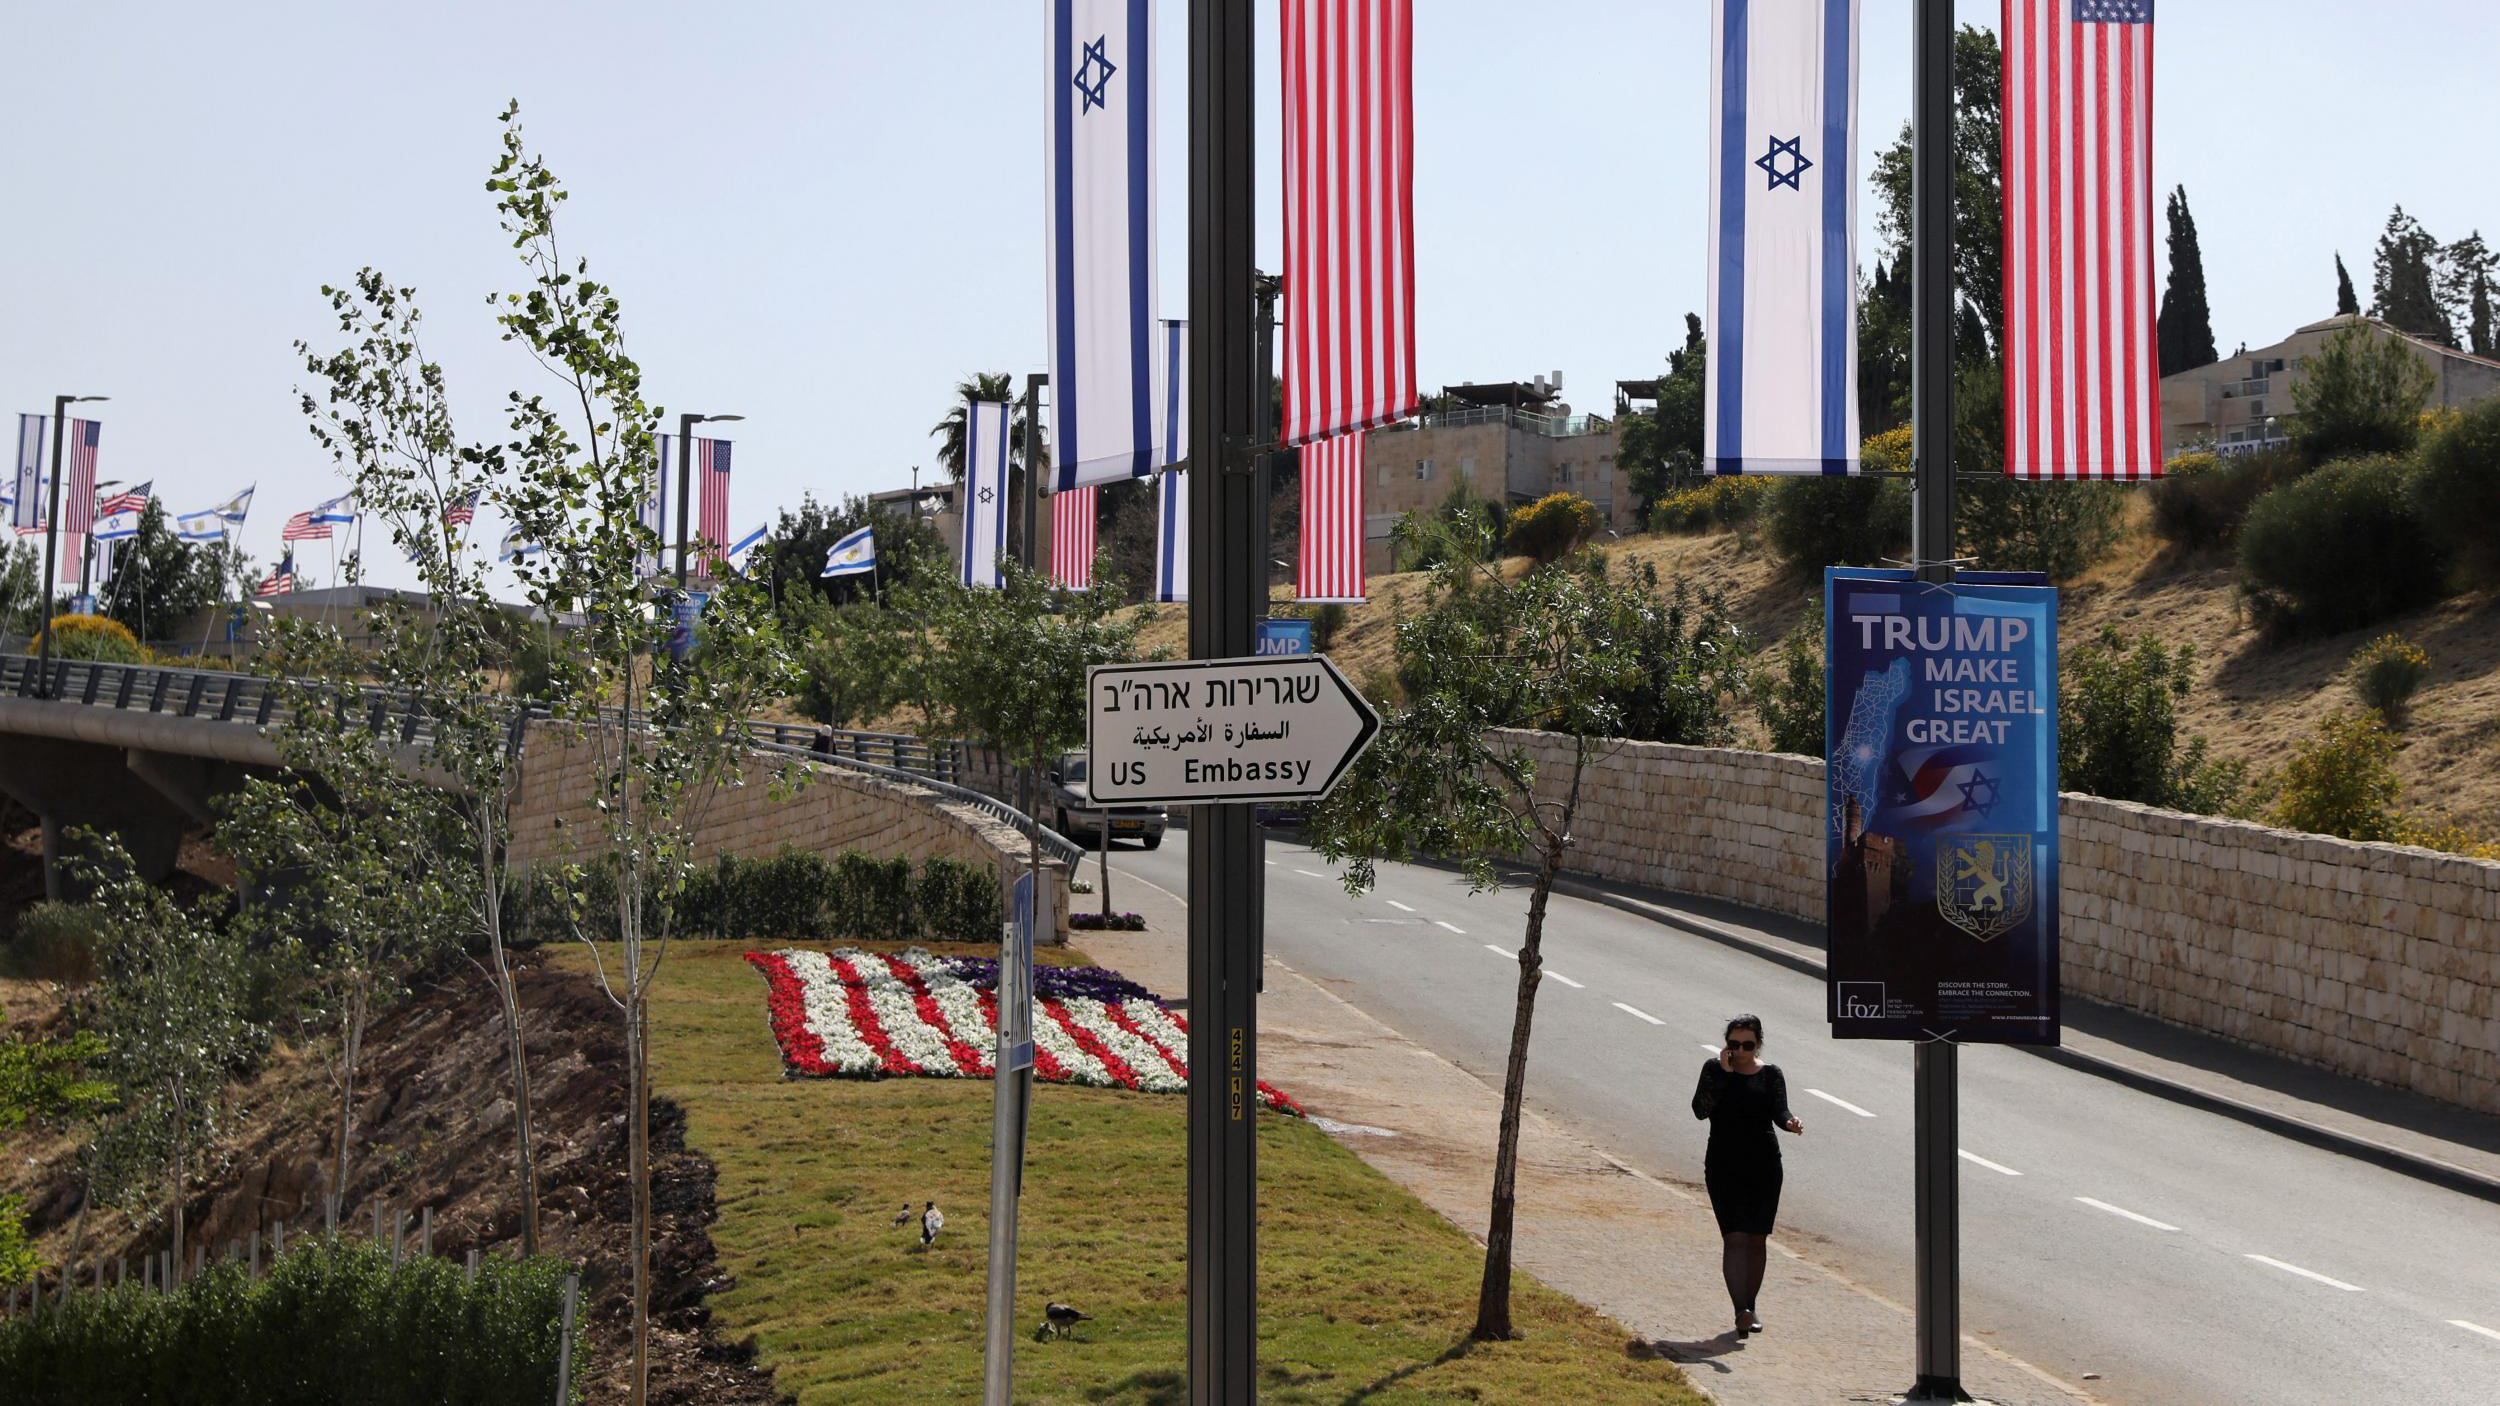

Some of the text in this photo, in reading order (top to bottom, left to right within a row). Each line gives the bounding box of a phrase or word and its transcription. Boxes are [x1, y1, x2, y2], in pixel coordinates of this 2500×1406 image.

[1256, 638, 1301, 654] UMP
[1852, 615, 2028, 652] TRUMP
[1925, 658, 2018, 683] MAKE
[1205, 675, 1320, 708] שגרירות
[1934, 688, 2045, 714] ISRAEL
[1132, 717, 1290, 751] السفارة الأمريكية
[1906, 719, 2012, 744] GREAT
[1111, 757, 1311, 786] US Embassy
[1846, 995, 1880, 1018] foz
[1232, 1029, 1241, 1118] 424 107
